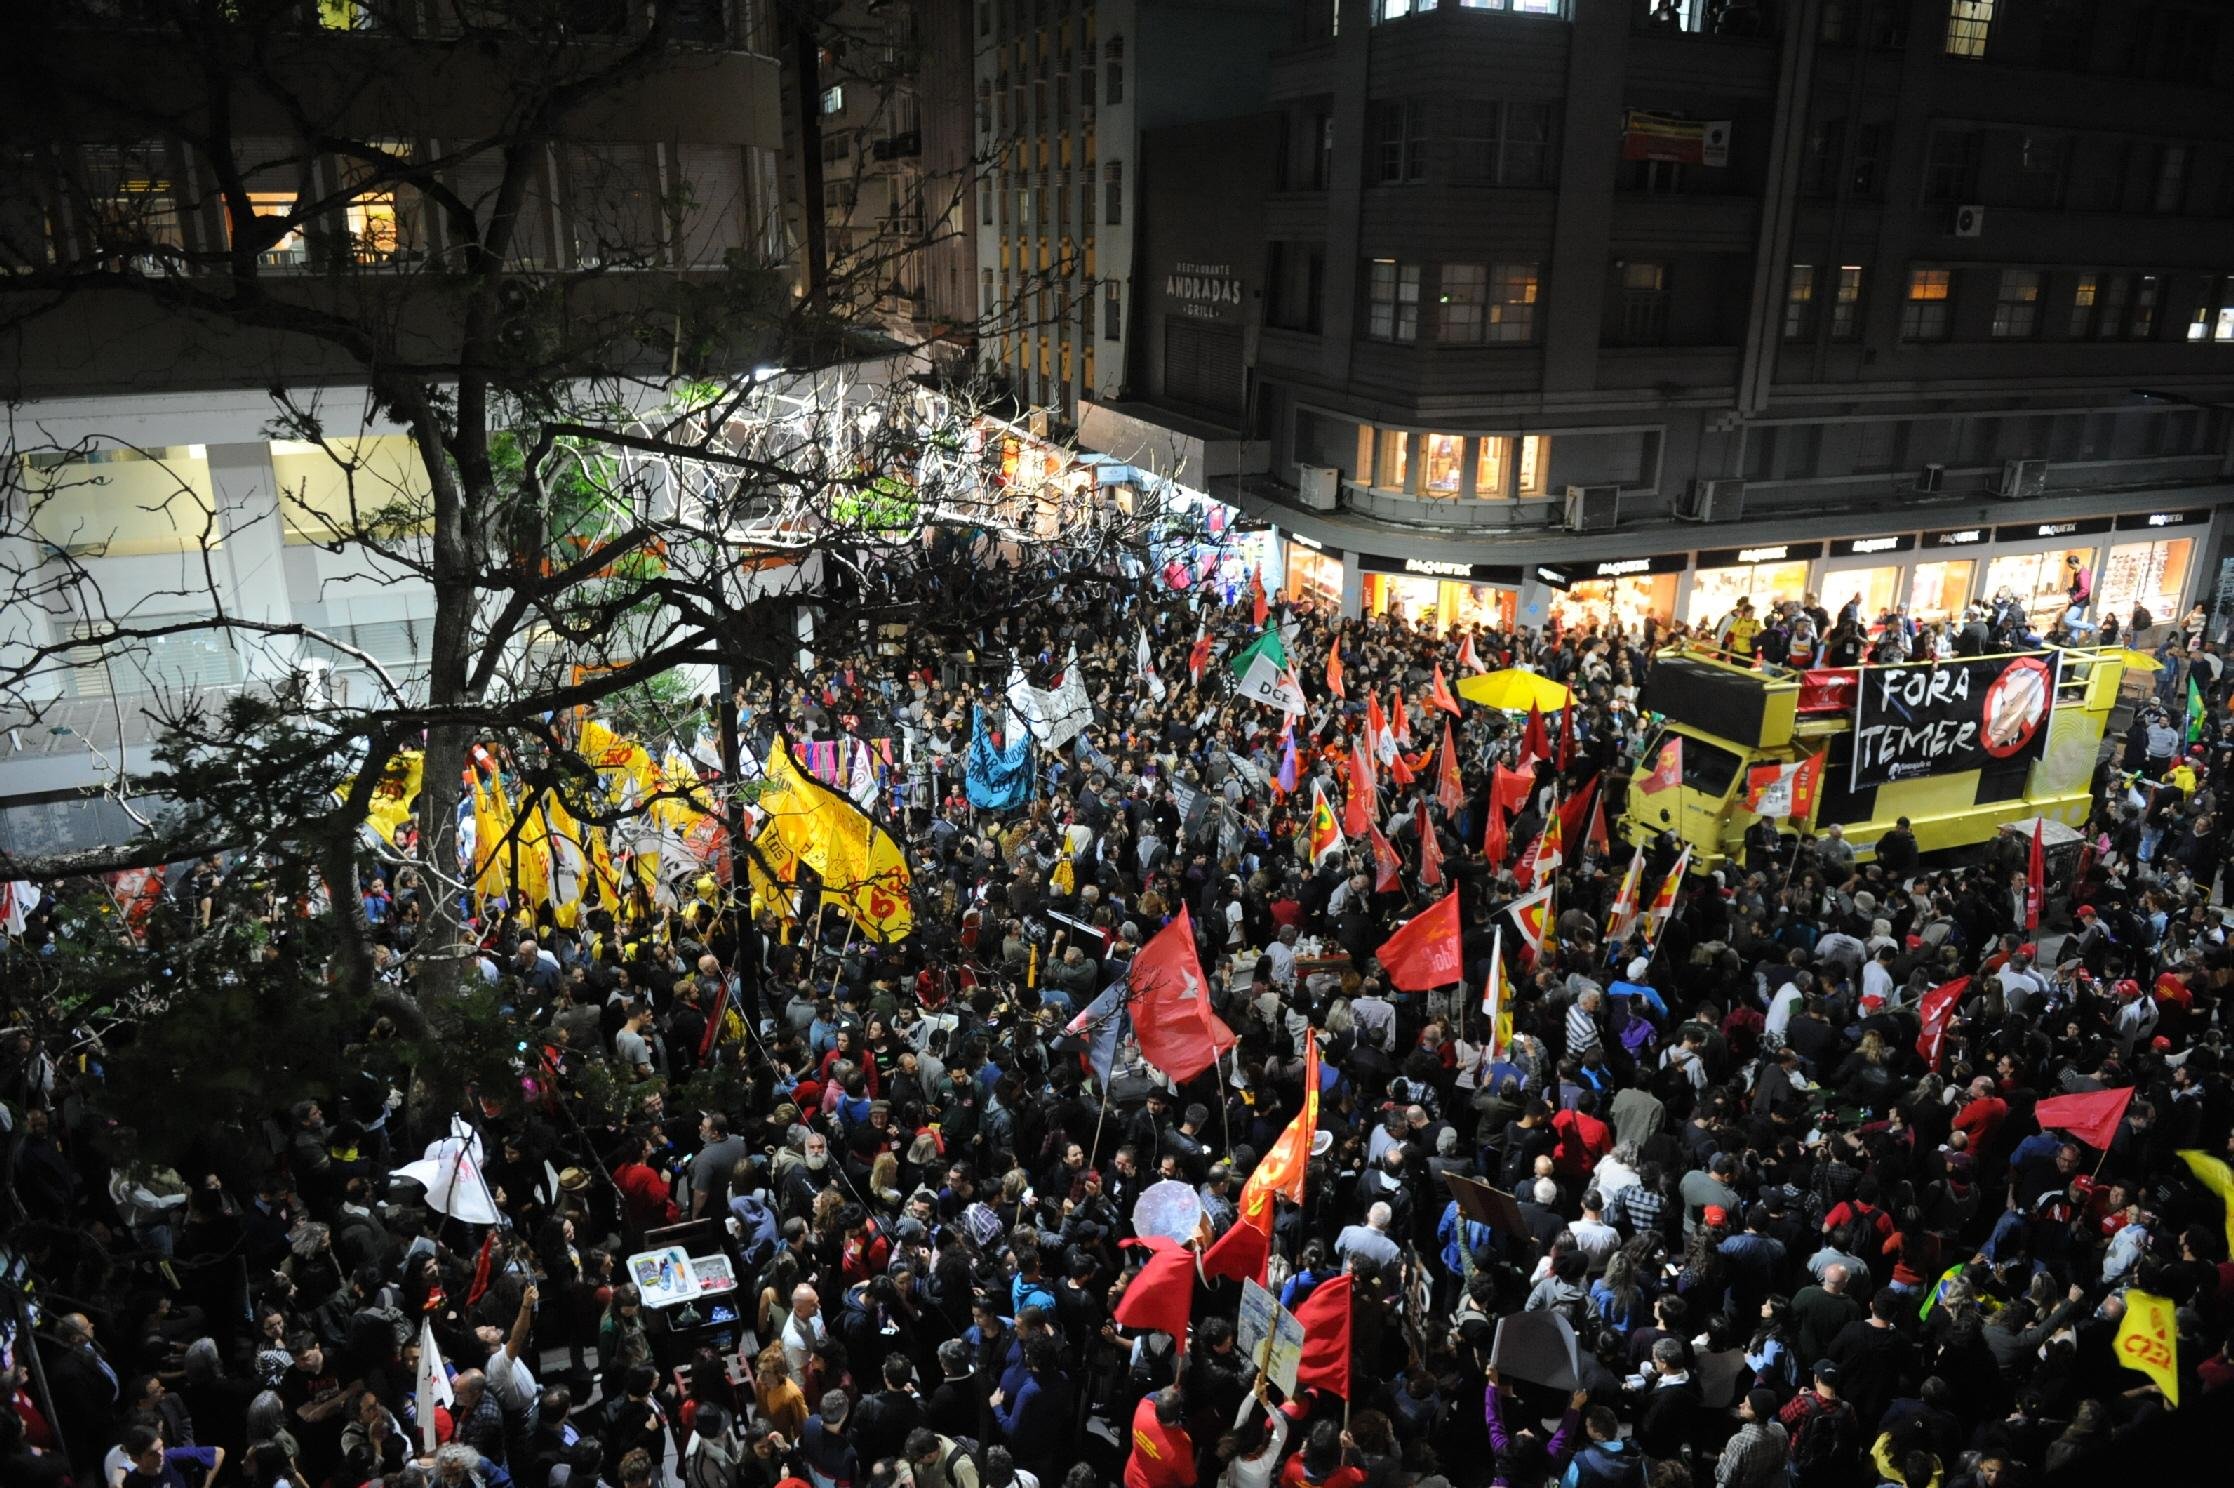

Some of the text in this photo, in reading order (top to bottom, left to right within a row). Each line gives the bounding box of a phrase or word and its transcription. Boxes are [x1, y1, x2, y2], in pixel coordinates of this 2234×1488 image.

[1166, 275, 1240, 304] ANDRADAS
[1259, 681, 1291, 703] DCE
[1881, 666, 1970, 713] FORA
[1860, 720, 1977, 769] TEMER
